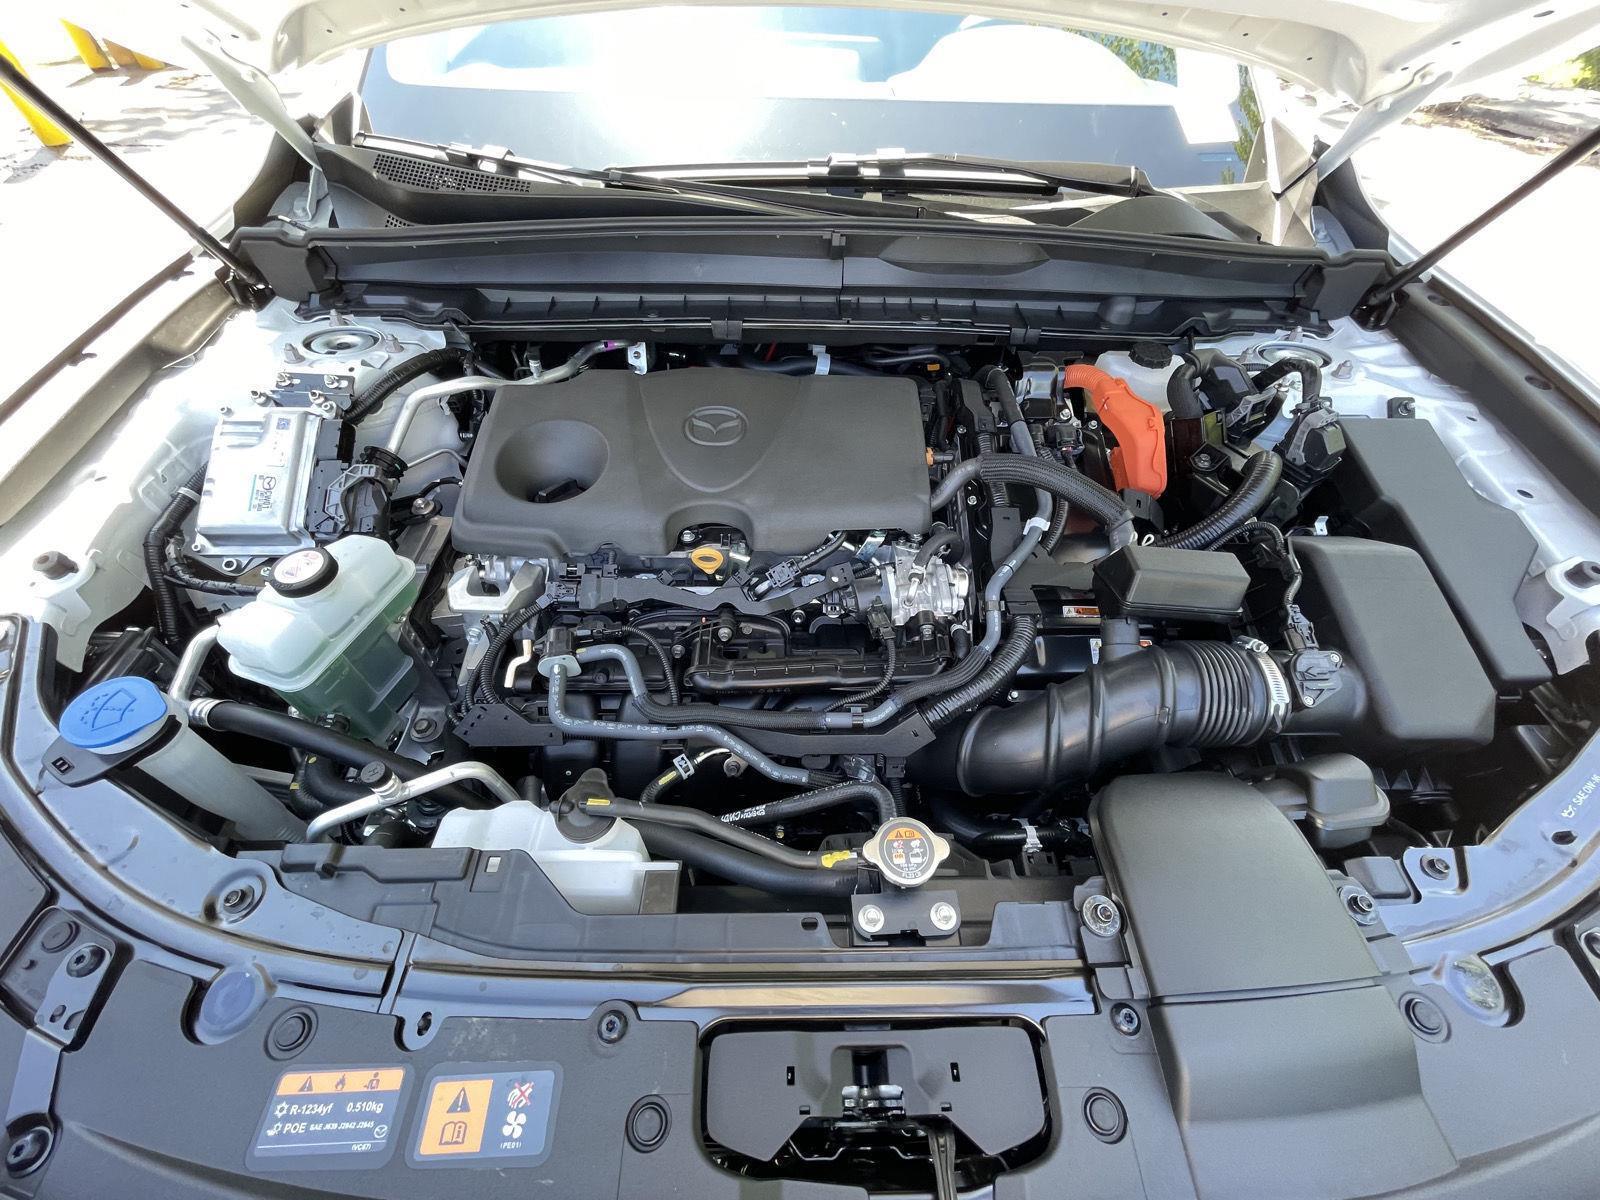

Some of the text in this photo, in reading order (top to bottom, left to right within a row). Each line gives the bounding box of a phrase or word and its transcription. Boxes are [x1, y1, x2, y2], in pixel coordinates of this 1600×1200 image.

[1572, 790, 1589, 805] SAE
[289, 1101, 384, 1116] R-1234yf 0.510kg
[283, 1122, 307, 1134] POE
